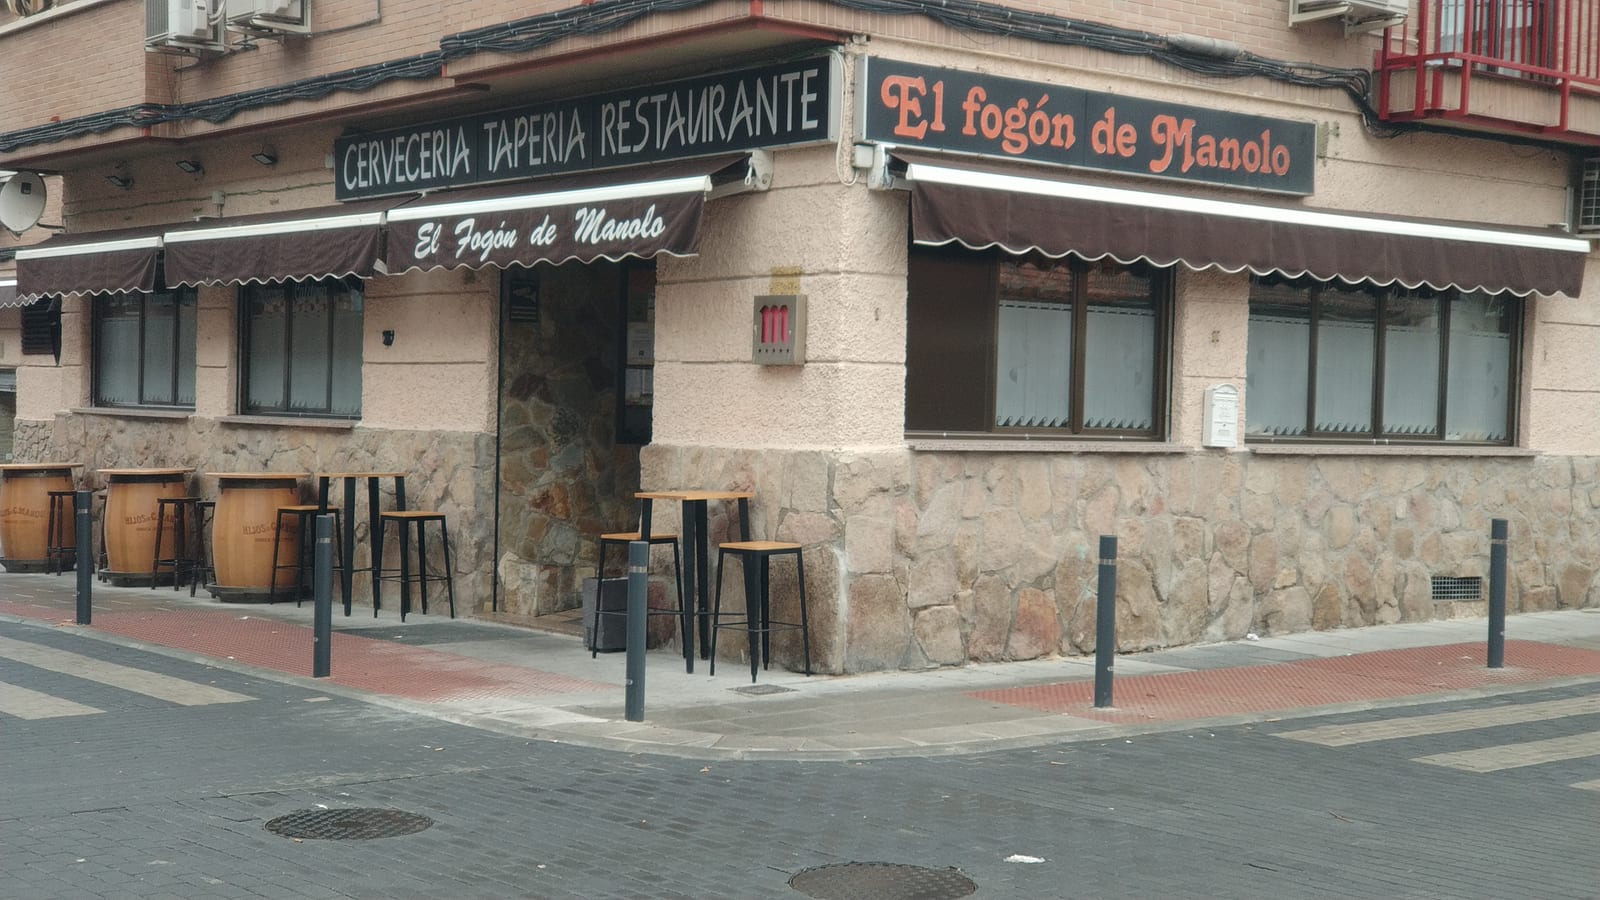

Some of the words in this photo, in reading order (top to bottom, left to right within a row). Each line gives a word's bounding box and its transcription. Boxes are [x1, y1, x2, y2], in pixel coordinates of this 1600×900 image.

[343, 127, 470, 191] CERVECERIA
[484, 107, 586, 172] TAPERIA
[601, 69, 819, 156] RESTAURANTE
[881, 76, 945, 140] El
[963, 86, 1075, 154] fogón
[1091, 108, 1137, 156] de
[1150, 115, 1290, 175] Manolo
[414, 221, 441, 259] El
[454, 217, 518, 261] Fogón
[530, 214, 558, 246] de
[574, 203, 666, 244] Manolo
